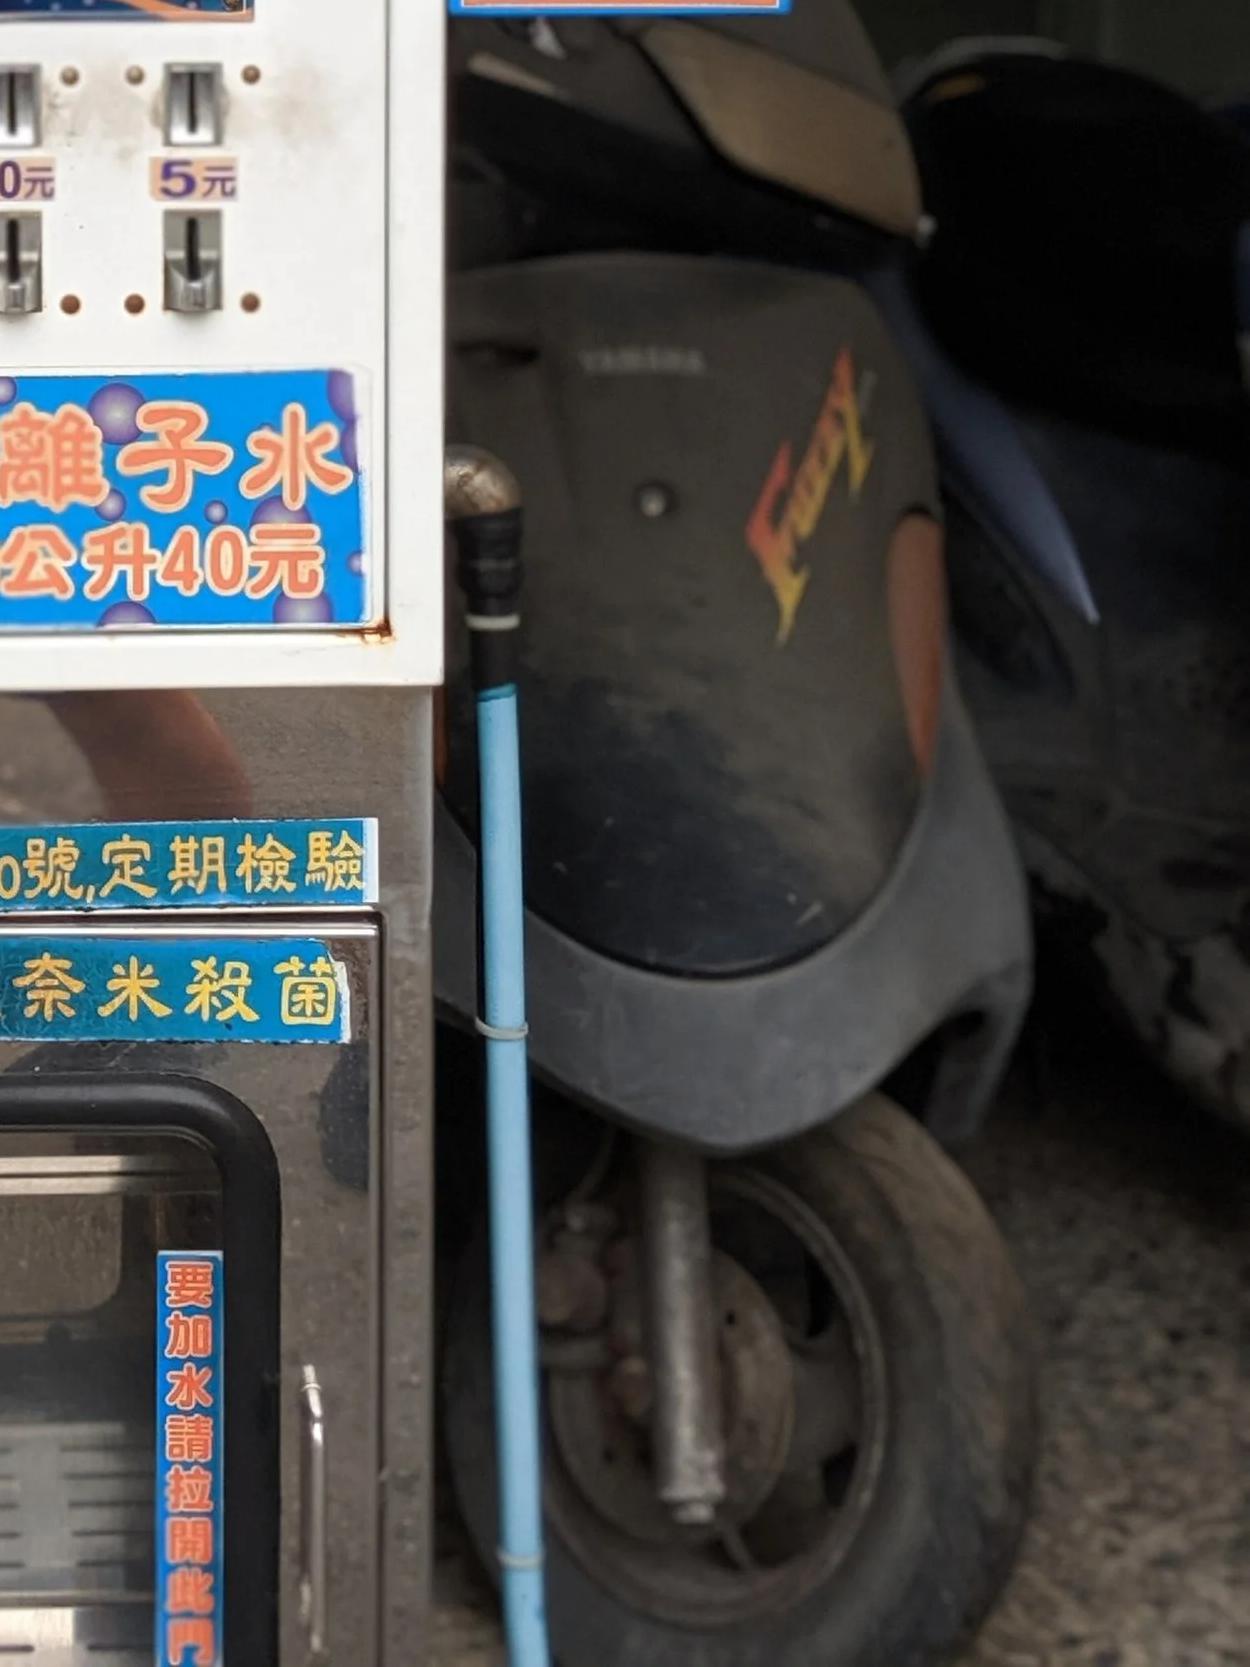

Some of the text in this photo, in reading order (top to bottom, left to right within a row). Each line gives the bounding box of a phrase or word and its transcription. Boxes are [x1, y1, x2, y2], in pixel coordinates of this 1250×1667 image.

[159, 157, 238, 200] 5元
[165, 1259, 215, 1667] 要加水請拉開此門
